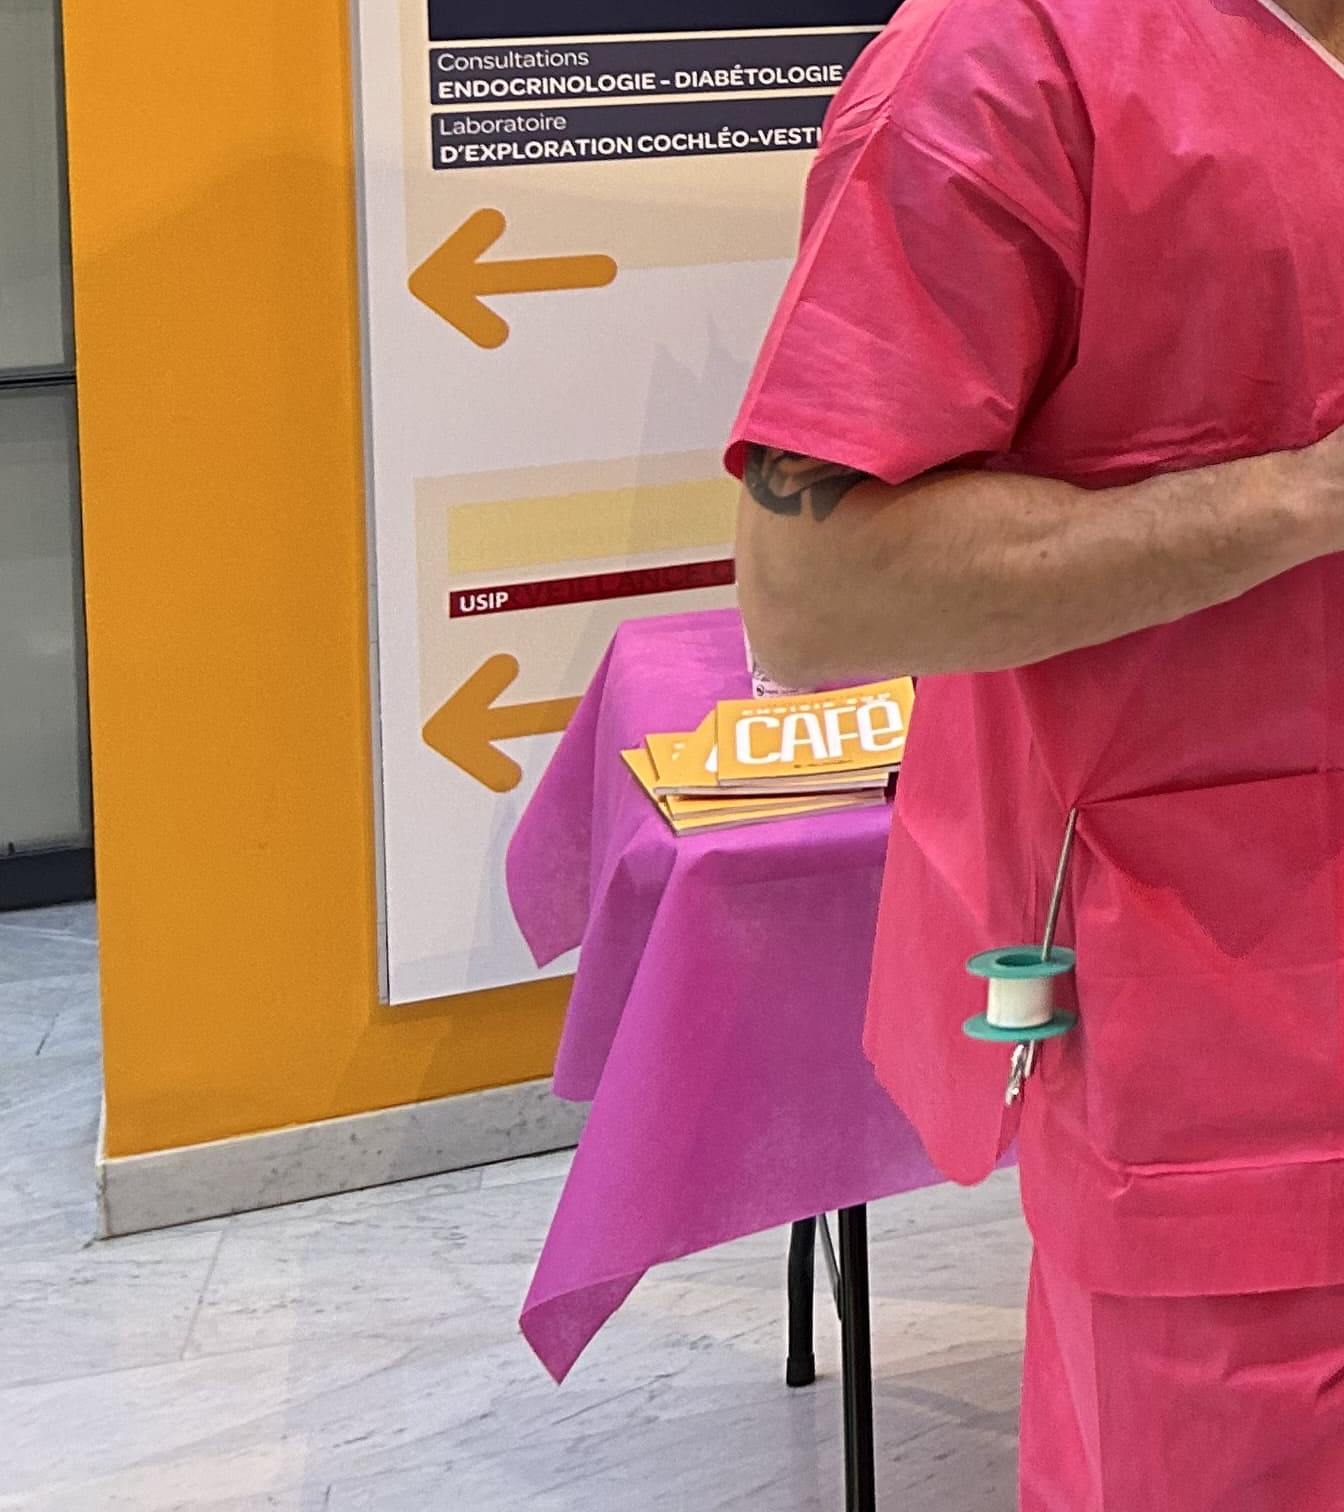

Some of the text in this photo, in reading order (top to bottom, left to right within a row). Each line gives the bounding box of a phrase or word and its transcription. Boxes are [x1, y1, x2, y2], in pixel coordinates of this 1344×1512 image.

[437, 49, 590, 72] Consultations
[438, 72, 657, 100] ENDOCRINOLOGIE
[674, 64, 843, 89] DIABÉTOLOGIE
[439, 112, 568, 137] Laboratoire
[439, 136, 634, 165] D'EXPLORATION
[459, 591, 509, 612] USIP
